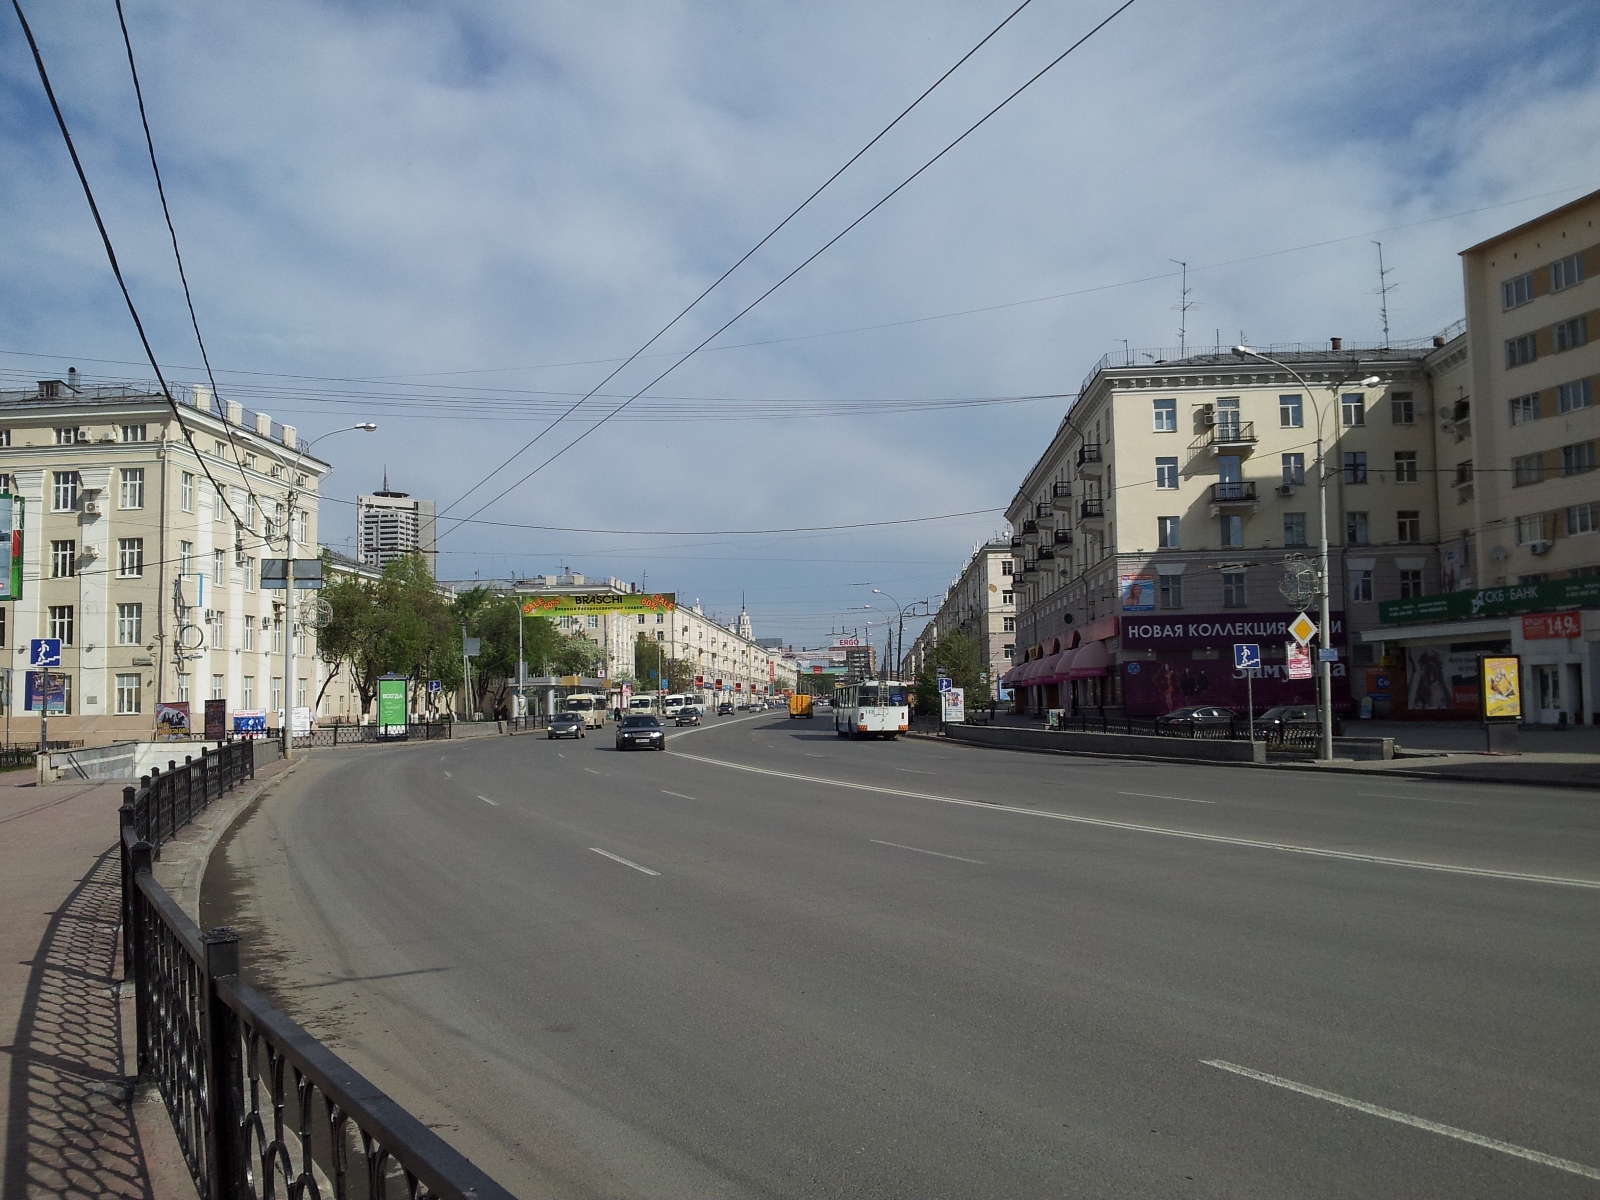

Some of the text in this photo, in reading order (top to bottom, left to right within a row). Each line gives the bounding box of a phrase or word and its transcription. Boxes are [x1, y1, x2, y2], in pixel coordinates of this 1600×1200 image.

[523, 597, 545, 613] SALE
[543, 597, 561, 611] 60%
[575, 595, 623, 604] BRASCHI
[641, 596, 659, 611] 60%
[653, 594, 675, 611] SALE
[1128, 624, 1183, 638] НОВАЯ
[1189, 621, 1286, 638] КОЛЛЕКЦИЯ
[1547, 615, 1579, 637] 14,9%
[1231, 661, 1346, 683] Зимука
